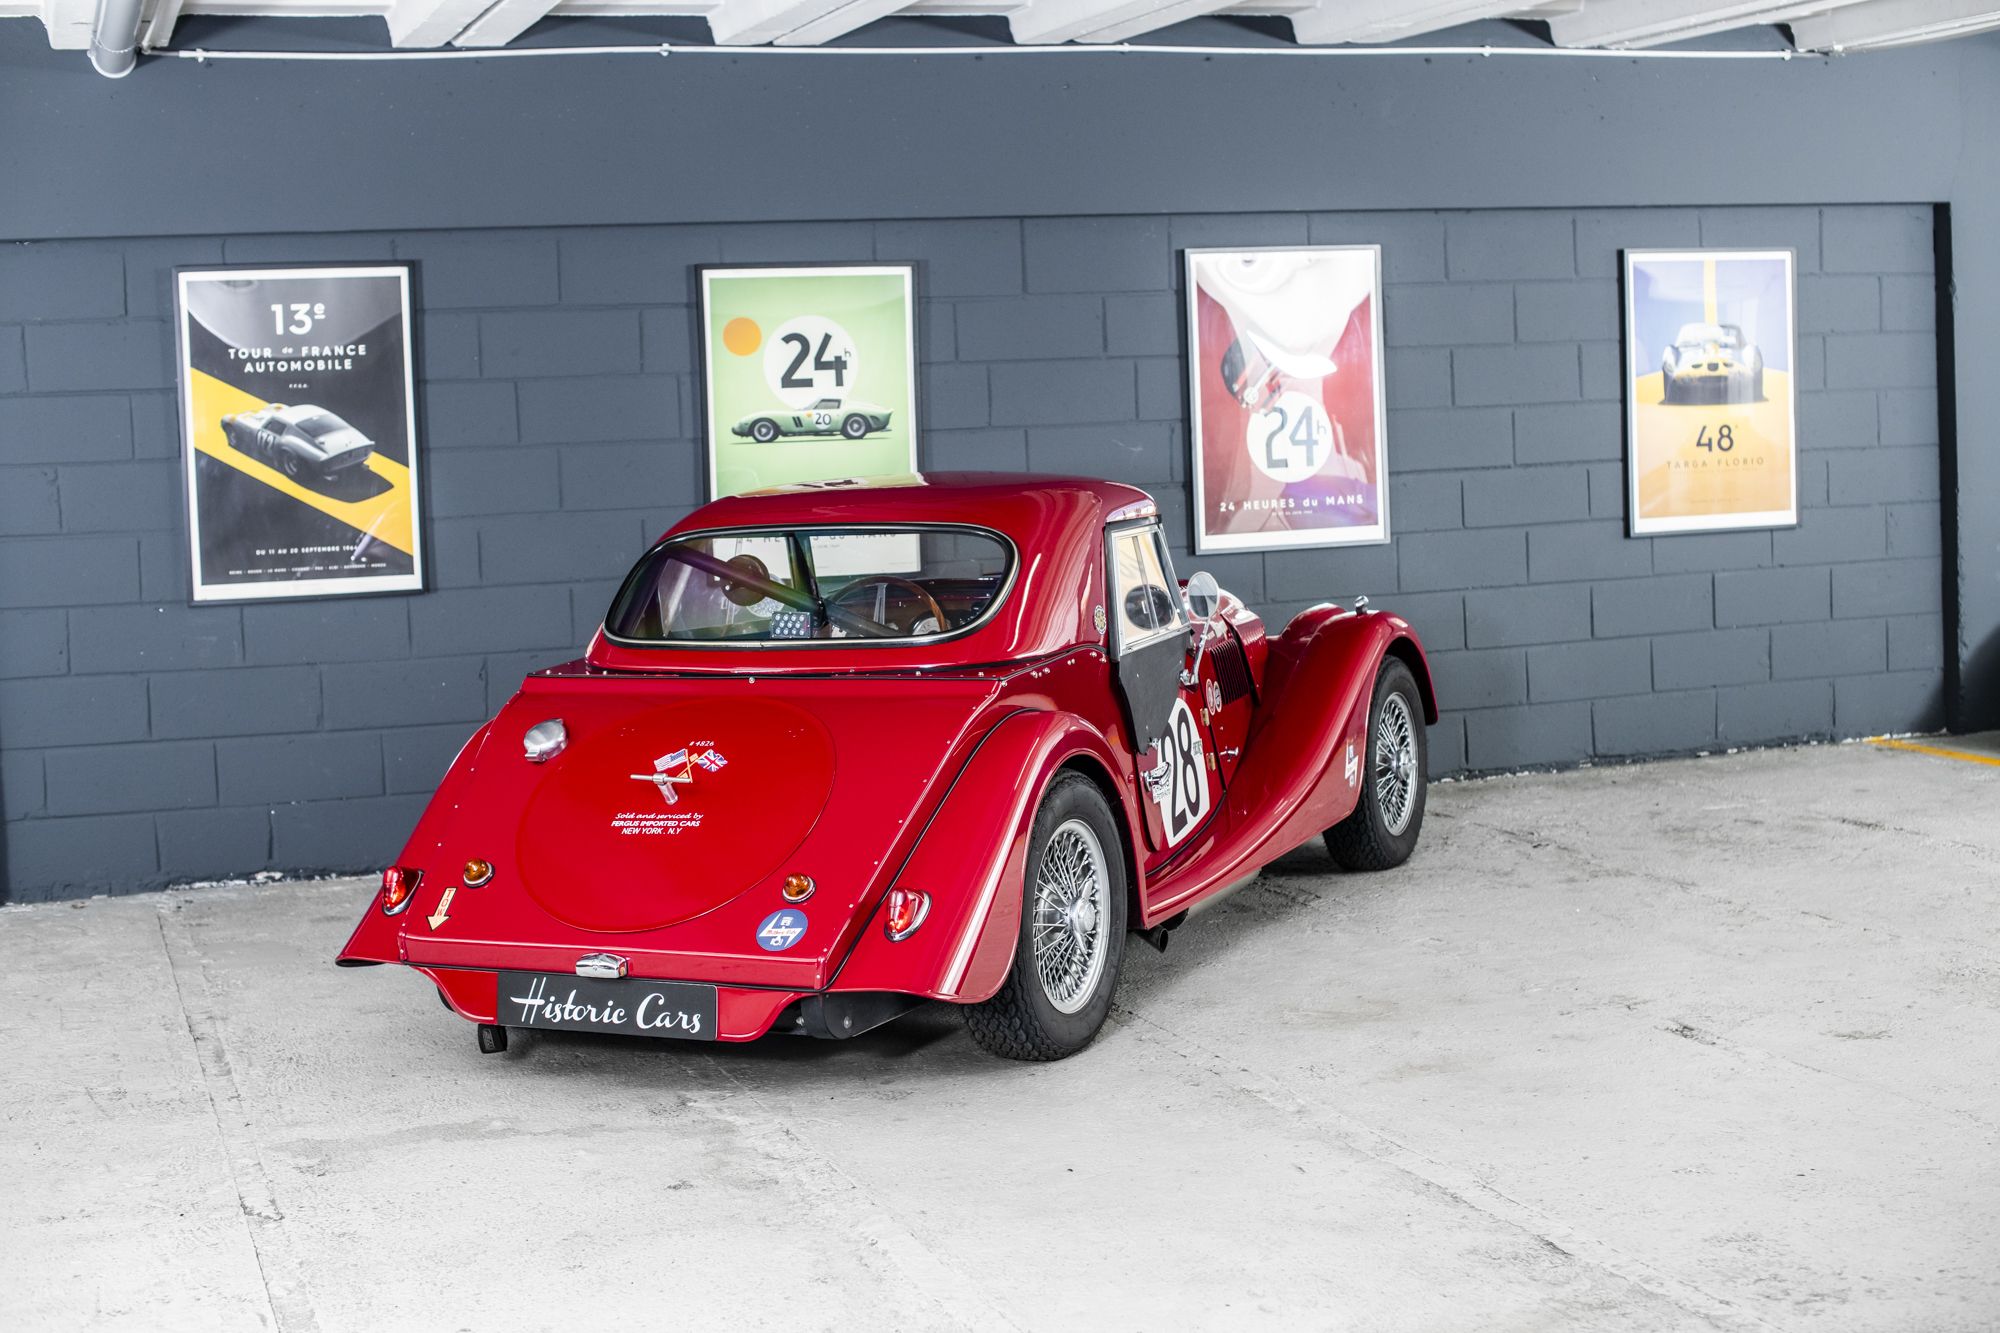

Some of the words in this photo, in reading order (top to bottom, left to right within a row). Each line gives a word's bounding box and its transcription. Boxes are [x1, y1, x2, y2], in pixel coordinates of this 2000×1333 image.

[228, 348, 272, 359] TOUR
[281, 346, 294, 354] de
[301, 345, 367, 356] FRANCE
[244, 359, 353, 373] AUTOMOBILE
[815, 412, 832, 426] 20
[1696, 424, 1734, 452] 48
[1666, 459, 1708, 470] TARGA
[1717, 456, 1764, 467] FLORIO
[1219, 501, 1235, 512] 24
[1243, 498, 1295, 511] HEURES
[1303, 497, 1318, 508] du
[1325, 494, 1364, 506] MANS
[301, 545, 340, 554] SEPTEMBRE
[1161, 707, 1201, 838] 28
[656, 812, 692, 820] serviced
[693, 812, 704, 820] by
[621, 827, 642, 835] NEW
[437, 889, 453, 917] TOW
[510, 976, 628, 1025] Historic
[636, 993, 702, 1034] Cars
